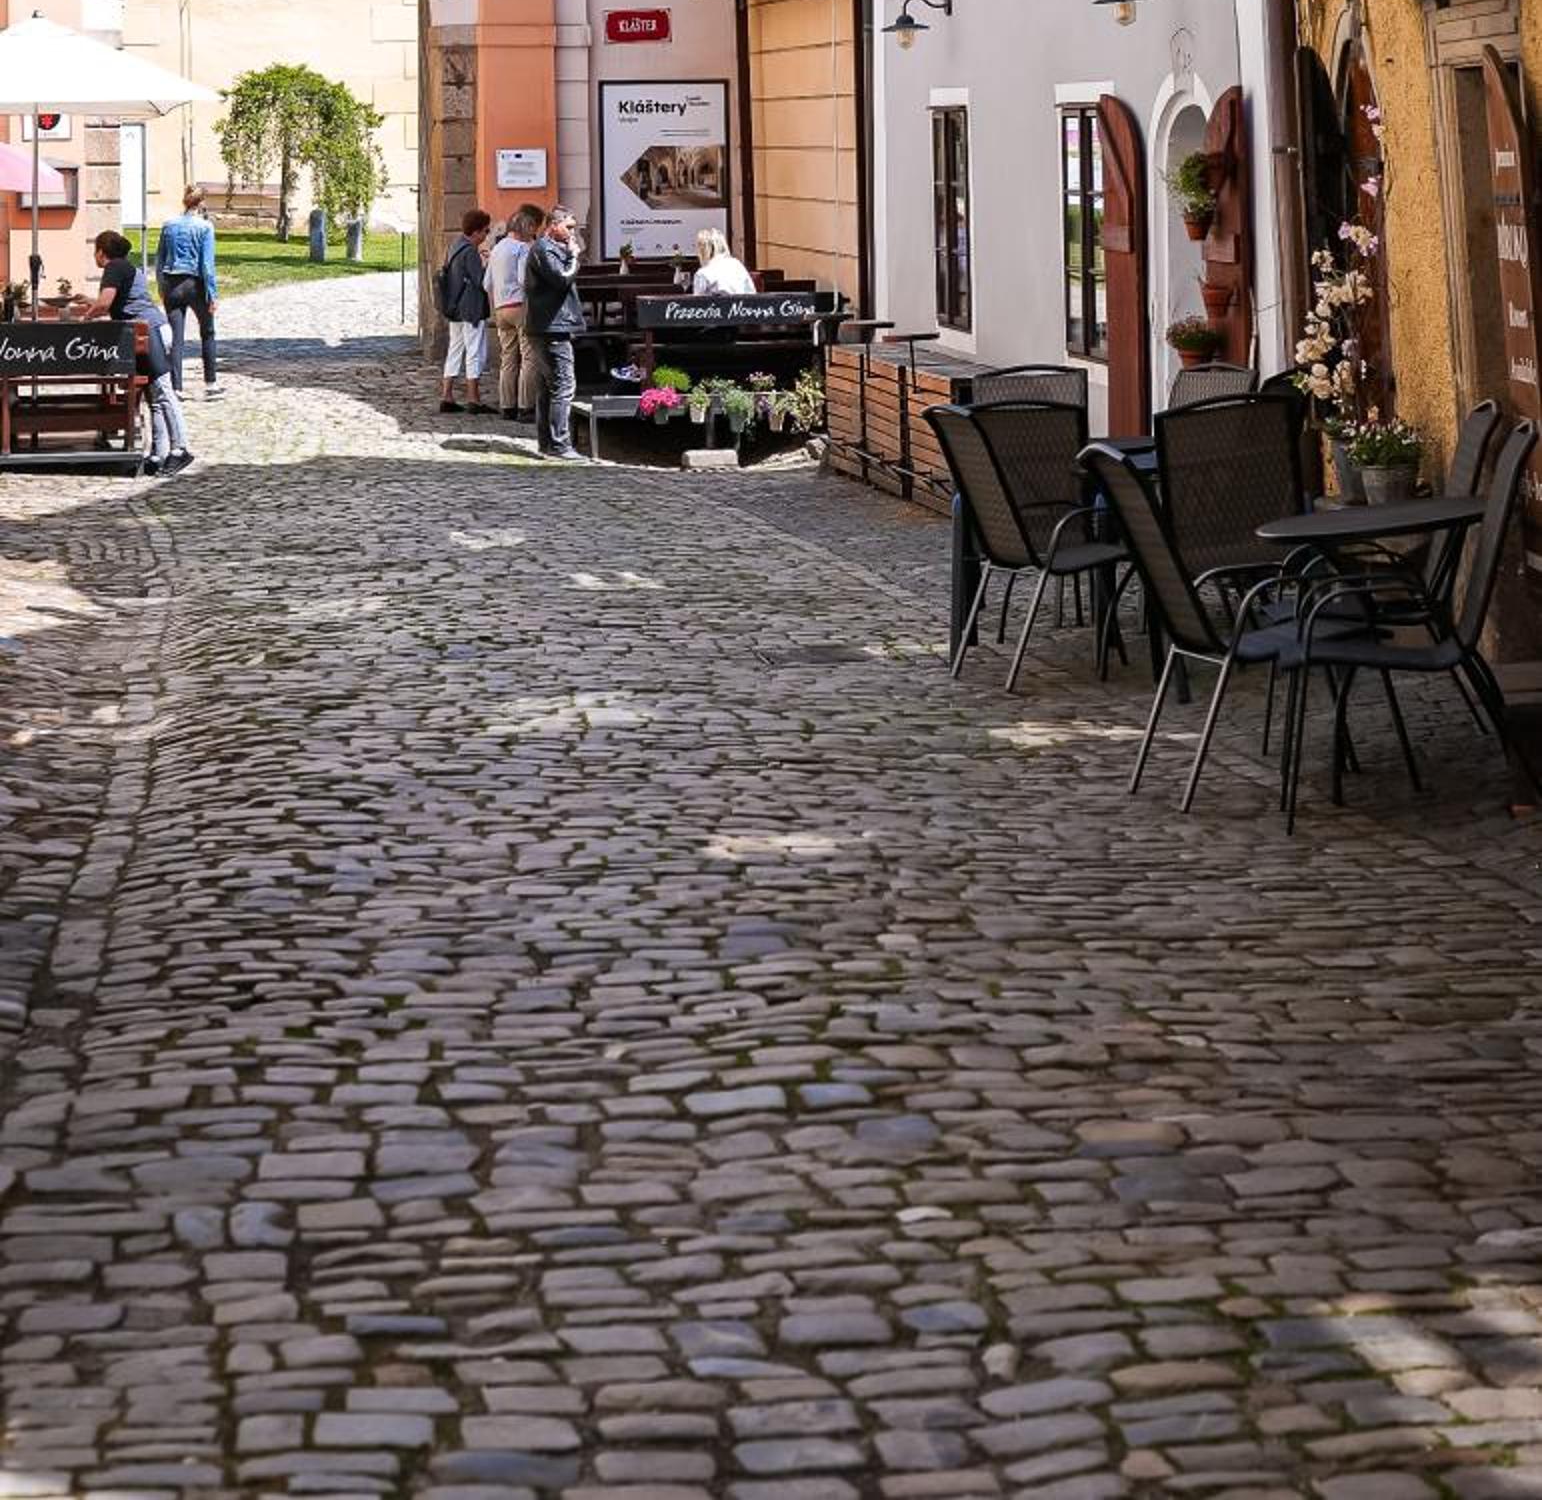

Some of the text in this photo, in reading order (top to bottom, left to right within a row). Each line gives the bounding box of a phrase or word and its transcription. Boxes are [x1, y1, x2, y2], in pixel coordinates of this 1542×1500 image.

[618, 99, 687, 117] Kláštery
[665, 299, 815, 320] Pizzeria Nonna Gina
[65, 337, 119, 360] Gina
